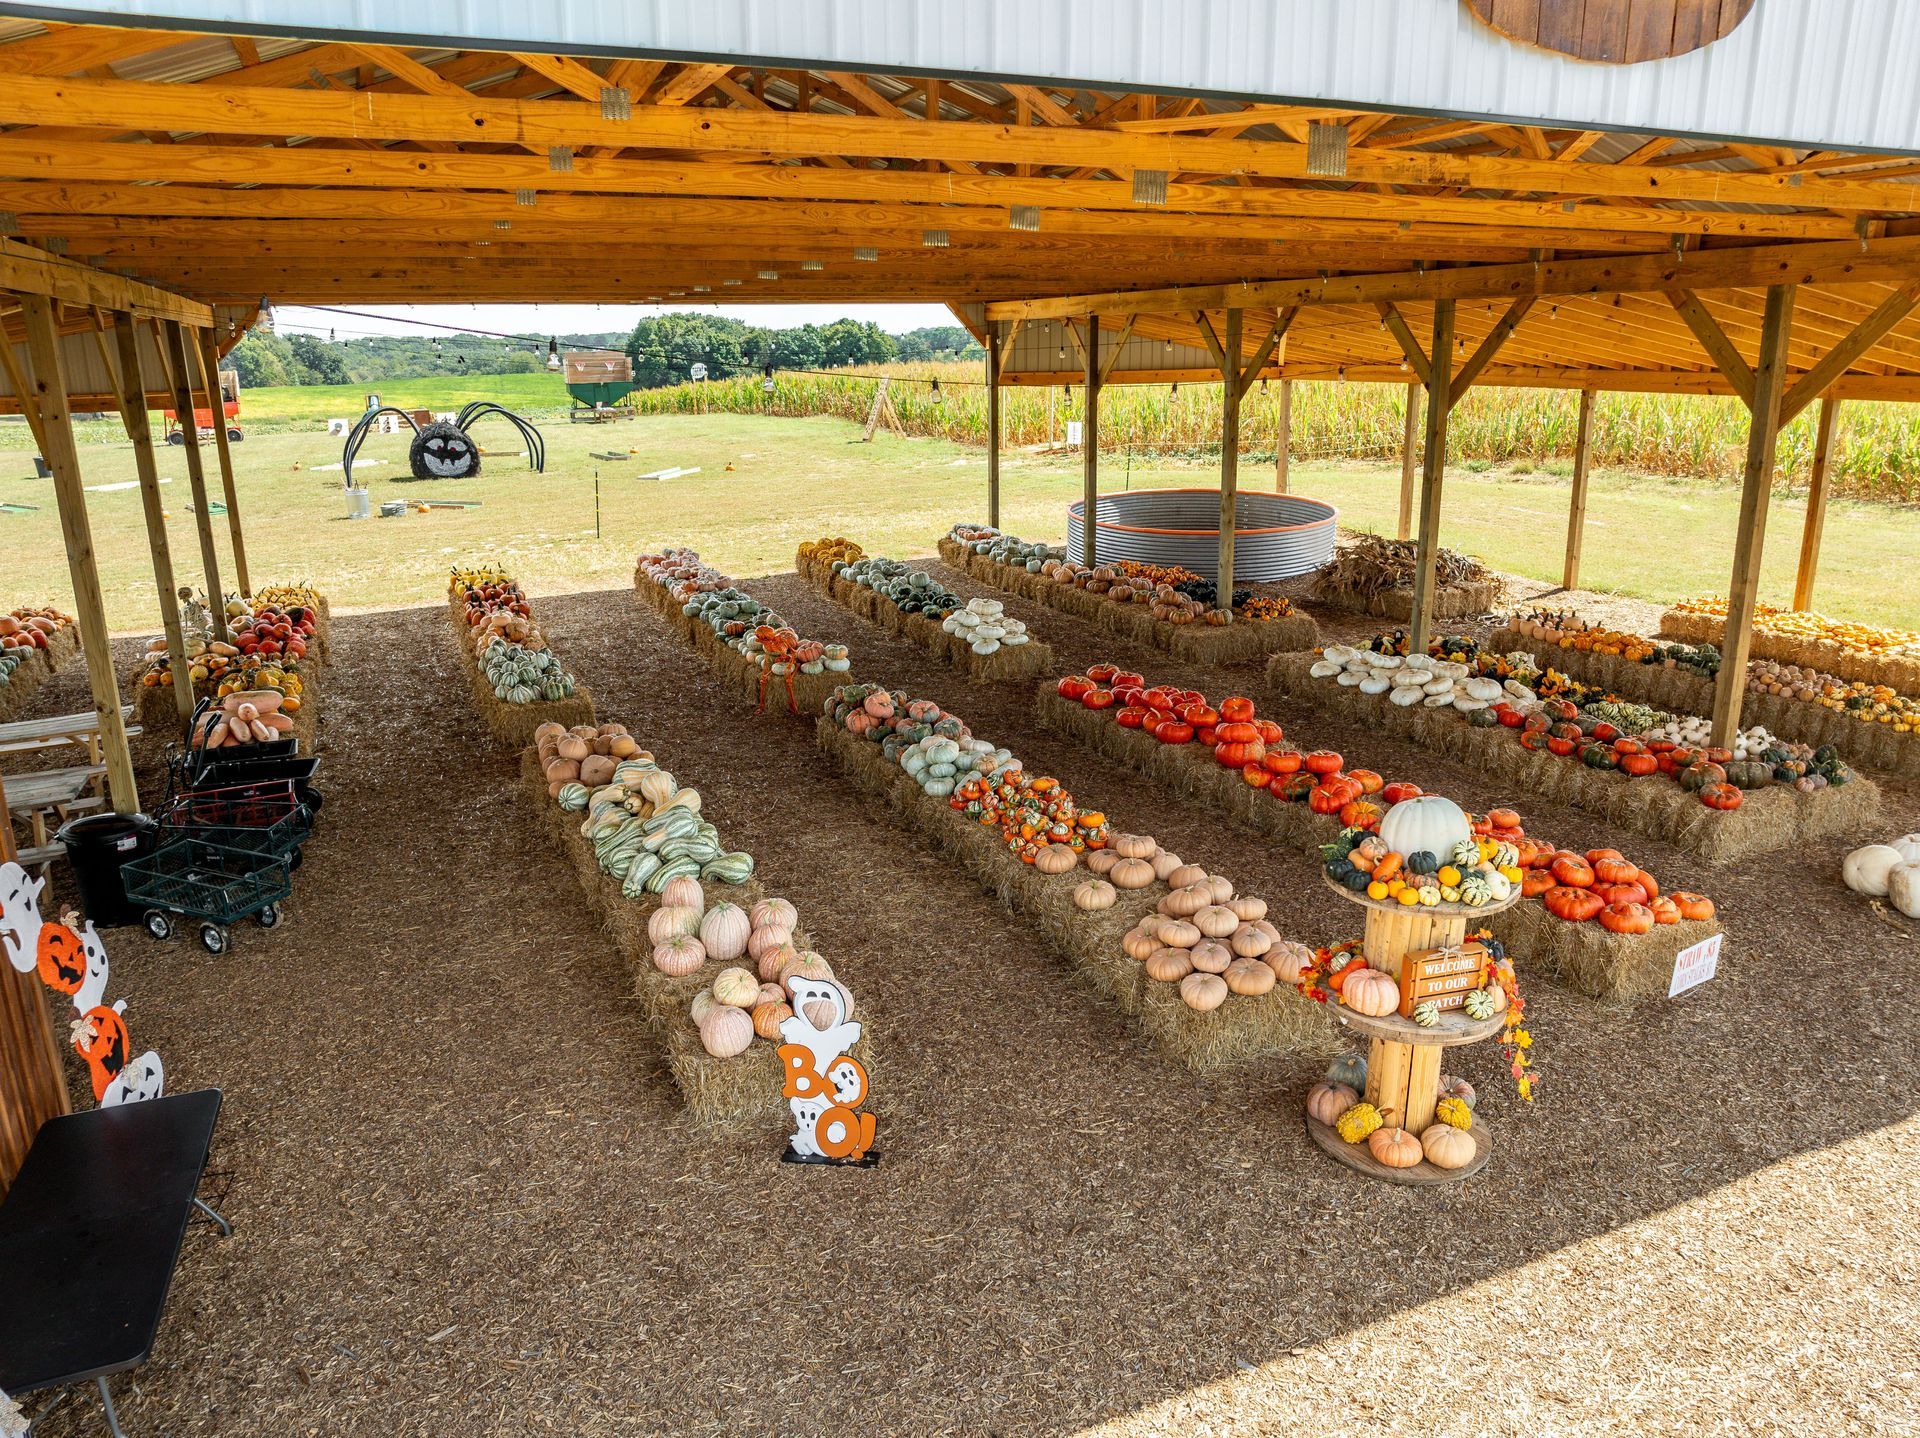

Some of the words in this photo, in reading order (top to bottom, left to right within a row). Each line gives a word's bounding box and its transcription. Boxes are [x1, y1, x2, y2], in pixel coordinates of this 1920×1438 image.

[1425, 958, 1475, 975] WELCOME
[1428, 981, 1442, 992] TO
[1445, 977, 1468, 989] OUR
